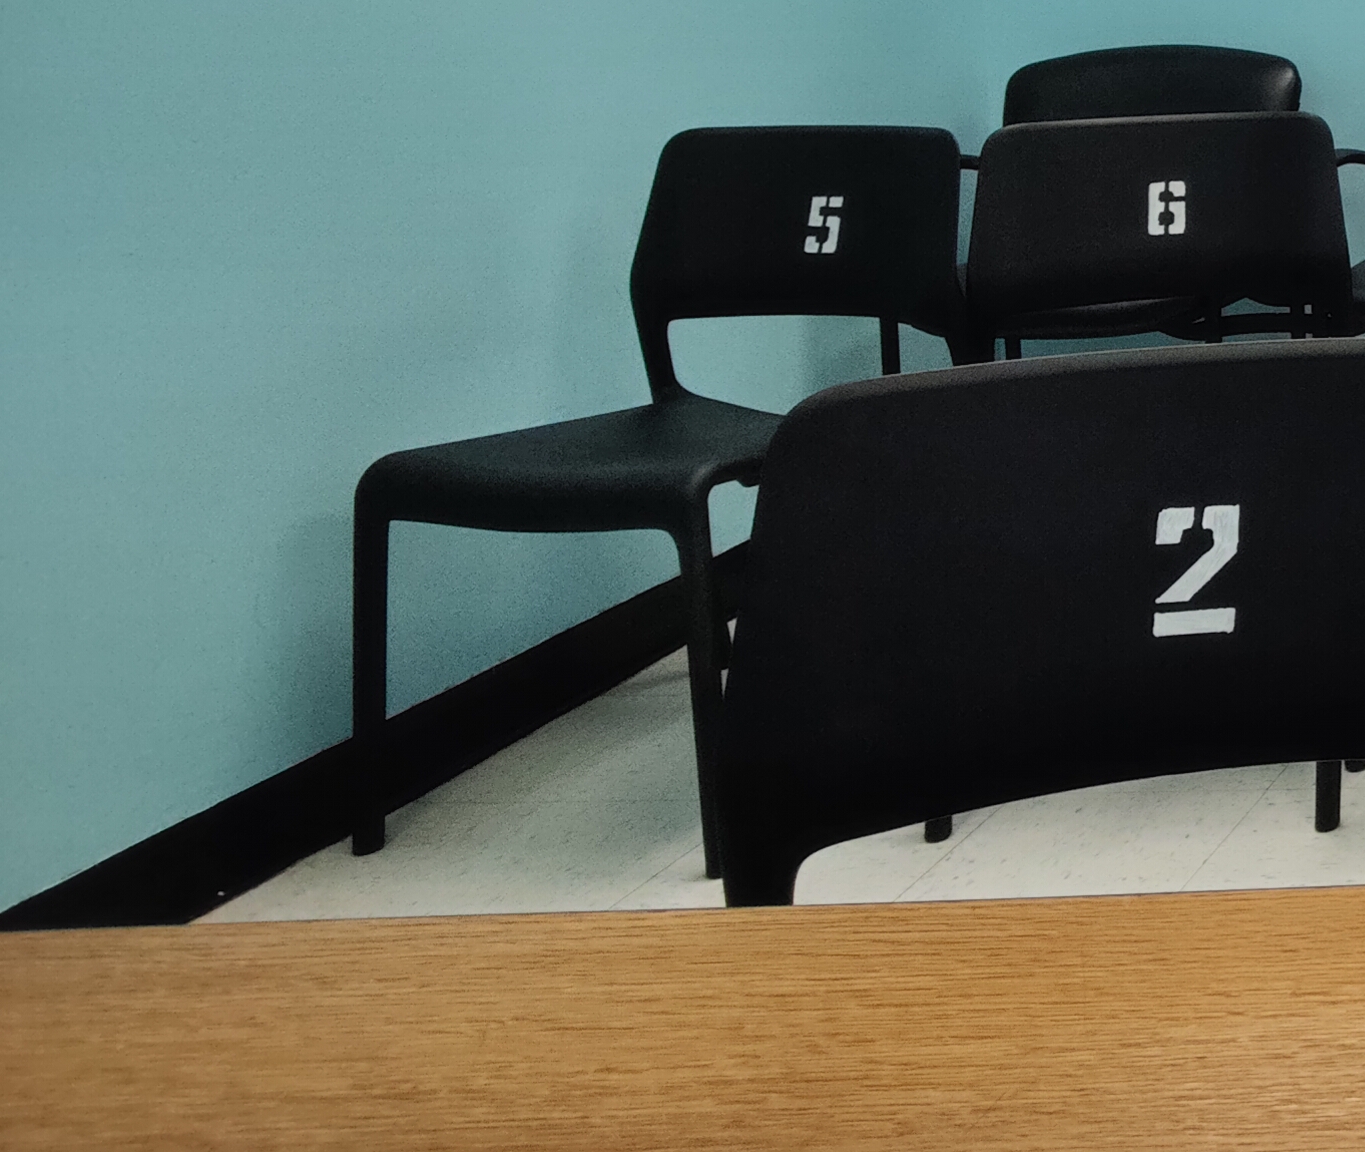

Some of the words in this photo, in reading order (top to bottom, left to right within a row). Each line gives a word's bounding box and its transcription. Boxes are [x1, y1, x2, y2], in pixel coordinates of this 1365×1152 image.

[803, 196, 844, 254] 5
[1147, 180, 1186, 236] 6
[1152, 504, 1240, 638] 2
